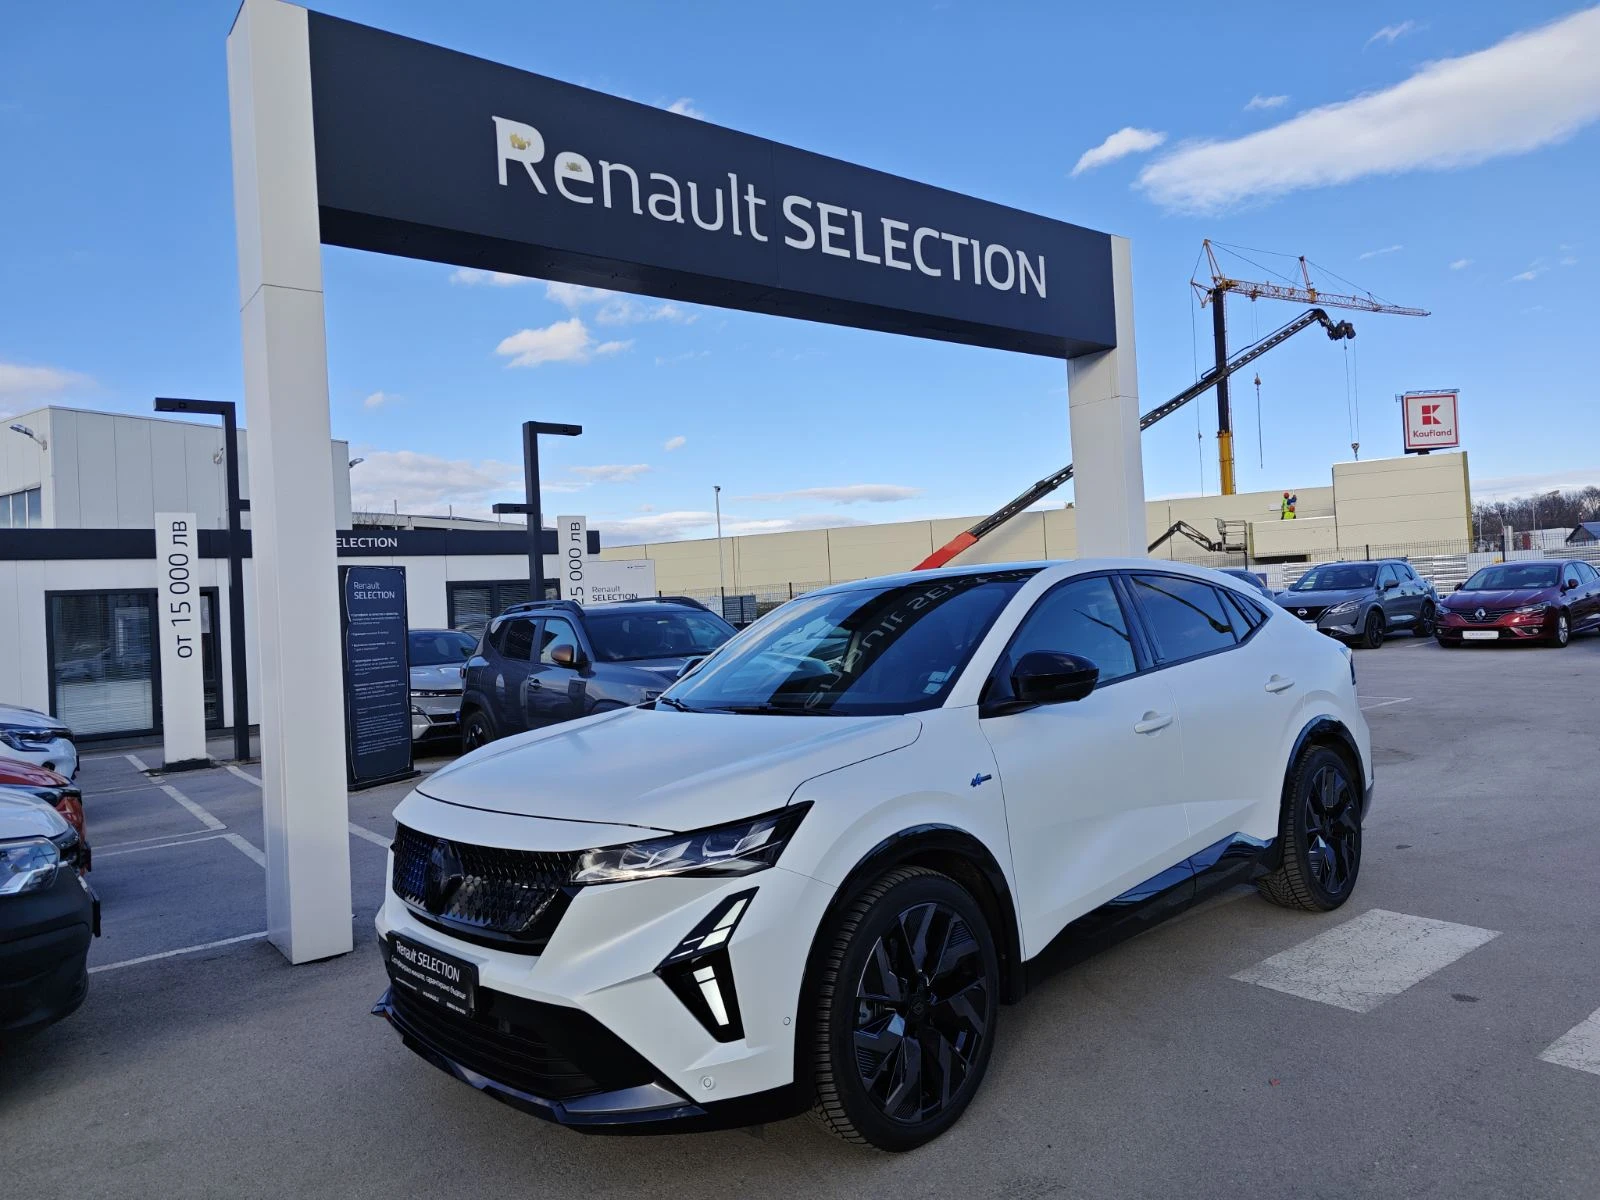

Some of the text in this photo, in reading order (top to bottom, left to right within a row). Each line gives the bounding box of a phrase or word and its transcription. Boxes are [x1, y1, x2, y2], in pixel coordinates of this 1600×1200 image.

[492, 115, 1046, 298] Renault SELECTION
[1413, 429, 1452, 438] Kaufland
[336, 537, 398, 548] ELECTION
[568, 547, 583, 581] 000
[168, 553, 190, 595] 000
[353, 581, 381, 590] Renault
[592, 585, 620, 593] Renault
[353, 591, 395, 600] SELECTION
[592, 593, 638, 602] SELECTION
[170, 601, 191, 627] 15
[396, 940, 460, 983] Renault SELECTION
